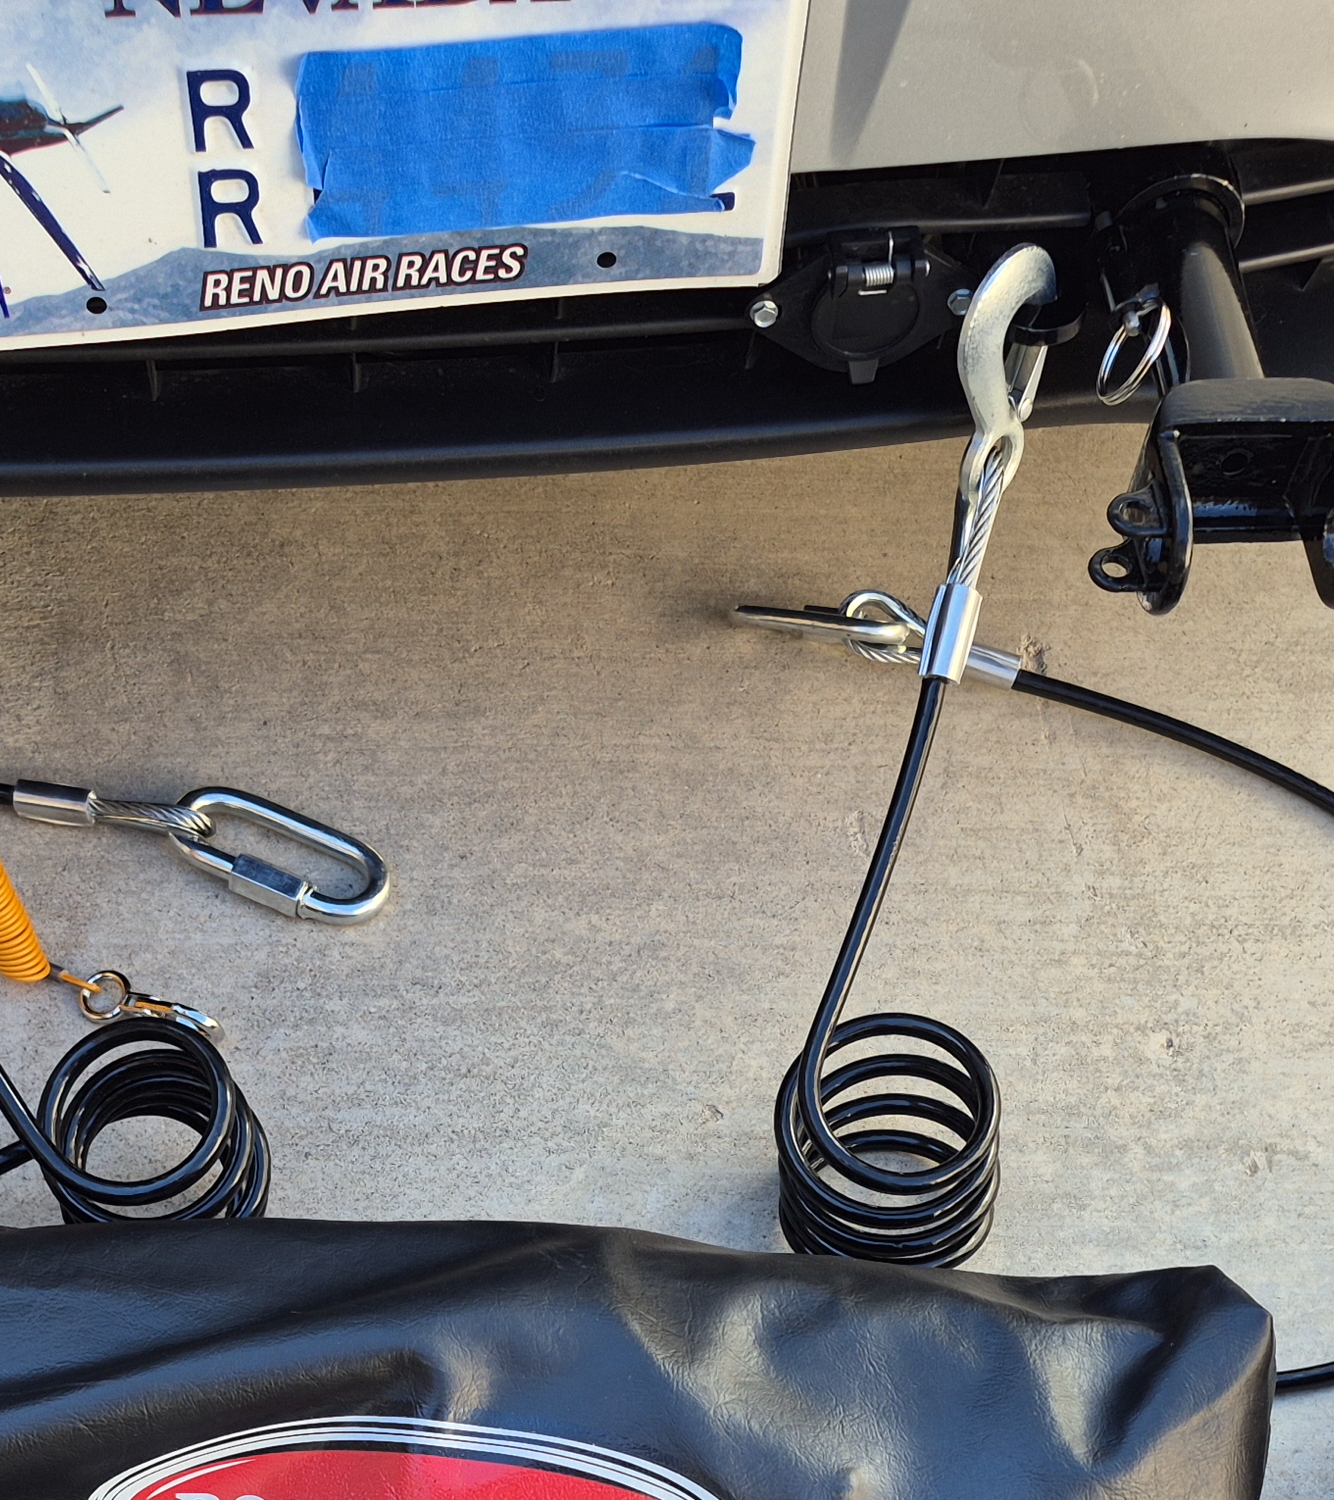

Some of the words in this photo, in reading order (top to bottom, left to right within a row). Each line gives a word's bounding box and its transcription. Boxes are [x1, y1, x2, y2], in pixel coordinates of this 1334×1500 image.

[201, 263, 313, 309] RENO
[318, 256, 389, 297] AIR
[394, 243, 527, 290] RACES
